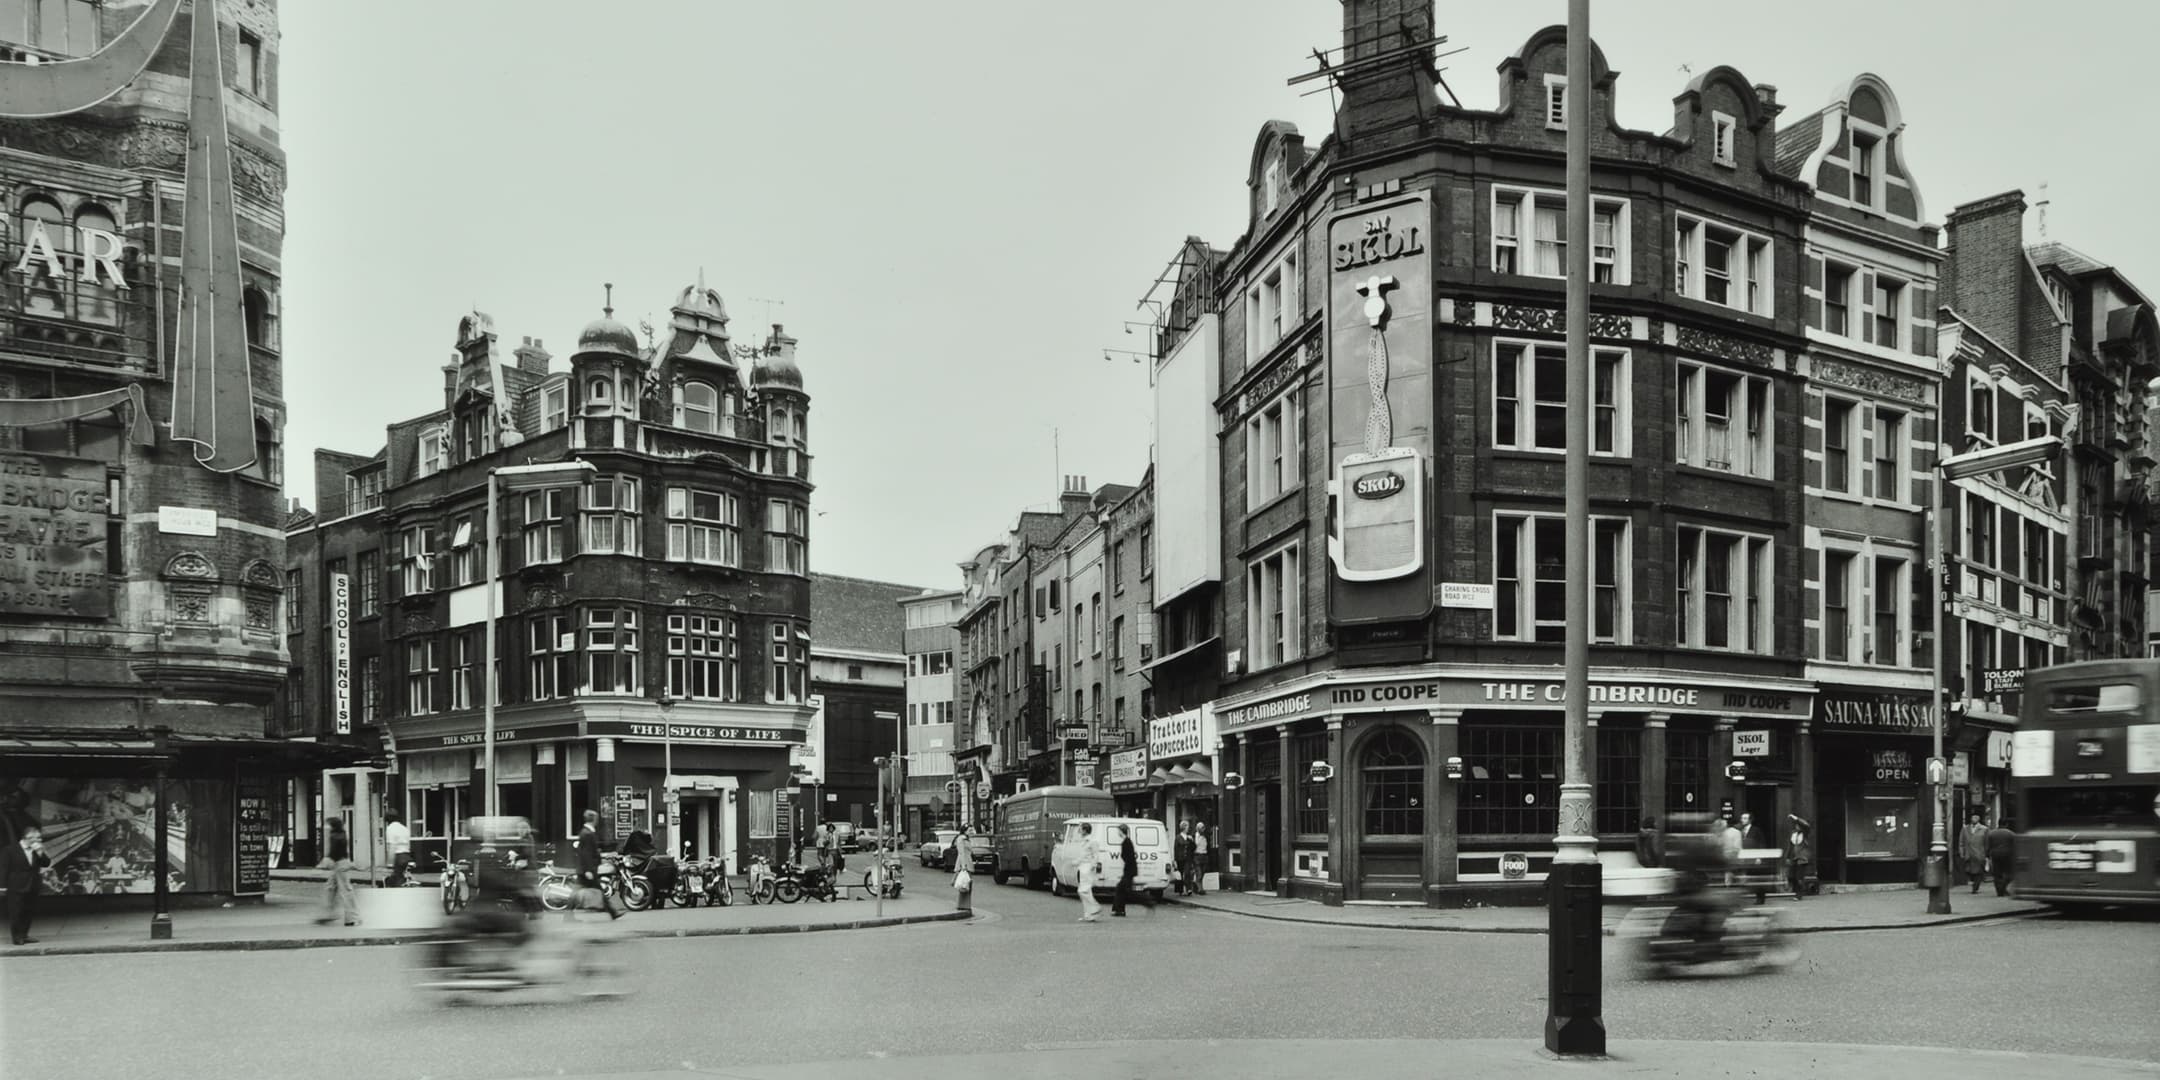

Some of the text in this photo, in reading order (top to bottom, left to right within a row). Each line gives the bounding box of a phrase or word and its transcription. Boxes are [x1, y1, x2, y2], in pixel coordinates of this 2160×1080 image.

[1364, 216, 1391, 235] SAY
[0, 212, 131, 290] AR
[1334, 227, 1424, 272] SKOL
[2, 459, 41, 476] THE
[1358, 476, 1400, 494] SKOL
[27, 548, 47, 562] IN
[1445, 585, 1491, 594] CHARING CROSS
[337, 578, 348, 639] SCHOOL
[1984, 670, 2025, 679] TOLSON
[338, 658, 349, 730] ENGLISH
[1332, 684, 1439, 704] IND COOPE
[1482, 683, 1699, 706] THE CMBRIDGE
[1723, 693, 1792, 711] IND COOPE
[1227, 693, 1312, 726] THE CAMBRIDGE
[1824, 699, 1874, 725] SAUNA
[443, 730, 516, 745] THE SPICE LIFE
[630, 724, 782, 740] THE SPICE OF LIFE
[1152, 718, 1197, 740] Trattoria
[1151, 733, 1200, 757] Cappuccetto
[1737, 734, 1766, 744] SKOL
[1740, 745, 1761, 754] Lager
[1876, 769, 1910, 780] OPEN
[241, 799, 259, 808] NOW
[1110, 851, 1158, 862] WDS
[1504, 860, 1526, 870] FOOD
